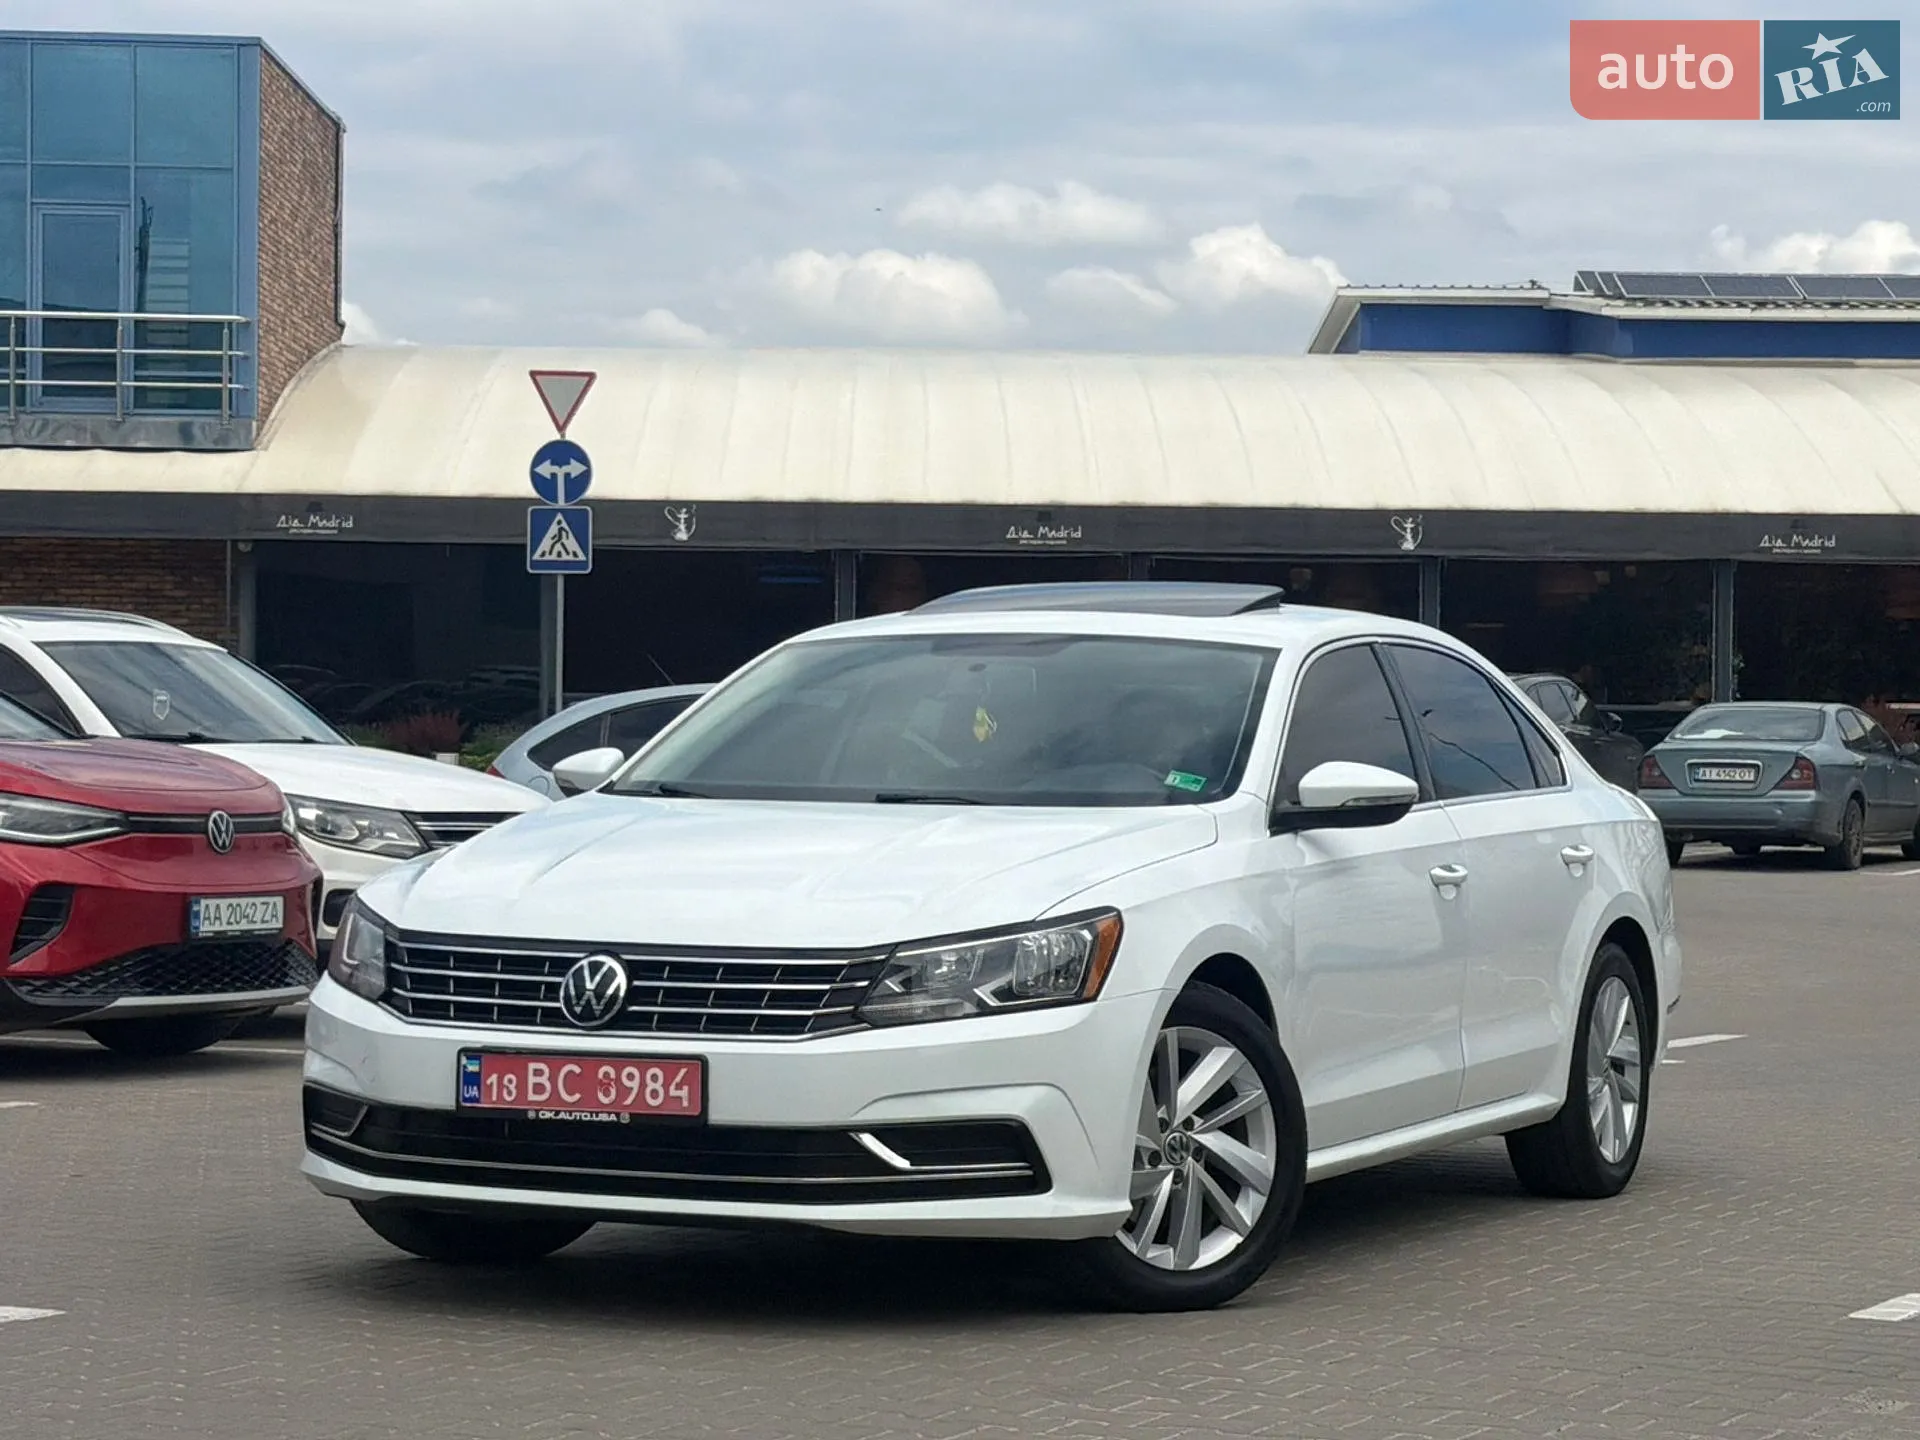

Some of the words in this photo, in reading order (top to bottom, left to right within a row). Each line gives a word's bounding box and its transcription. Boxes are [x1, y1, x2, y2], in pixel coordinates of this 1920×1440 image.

[307, 513, 353, 528] Madrid
[1037, 524, 1082, 539] Madrid
[1790, 533, 1835, 548] Madrid
[201, 903, 222, 927] AA
[226, 902, 259, 926] 2042
[260, 900, 280, 924] ZA
[486, 1073, 518, 1102] 18
[527, 1062, 582, 1103] BC
[463, 1083, 480, 1099] UA
